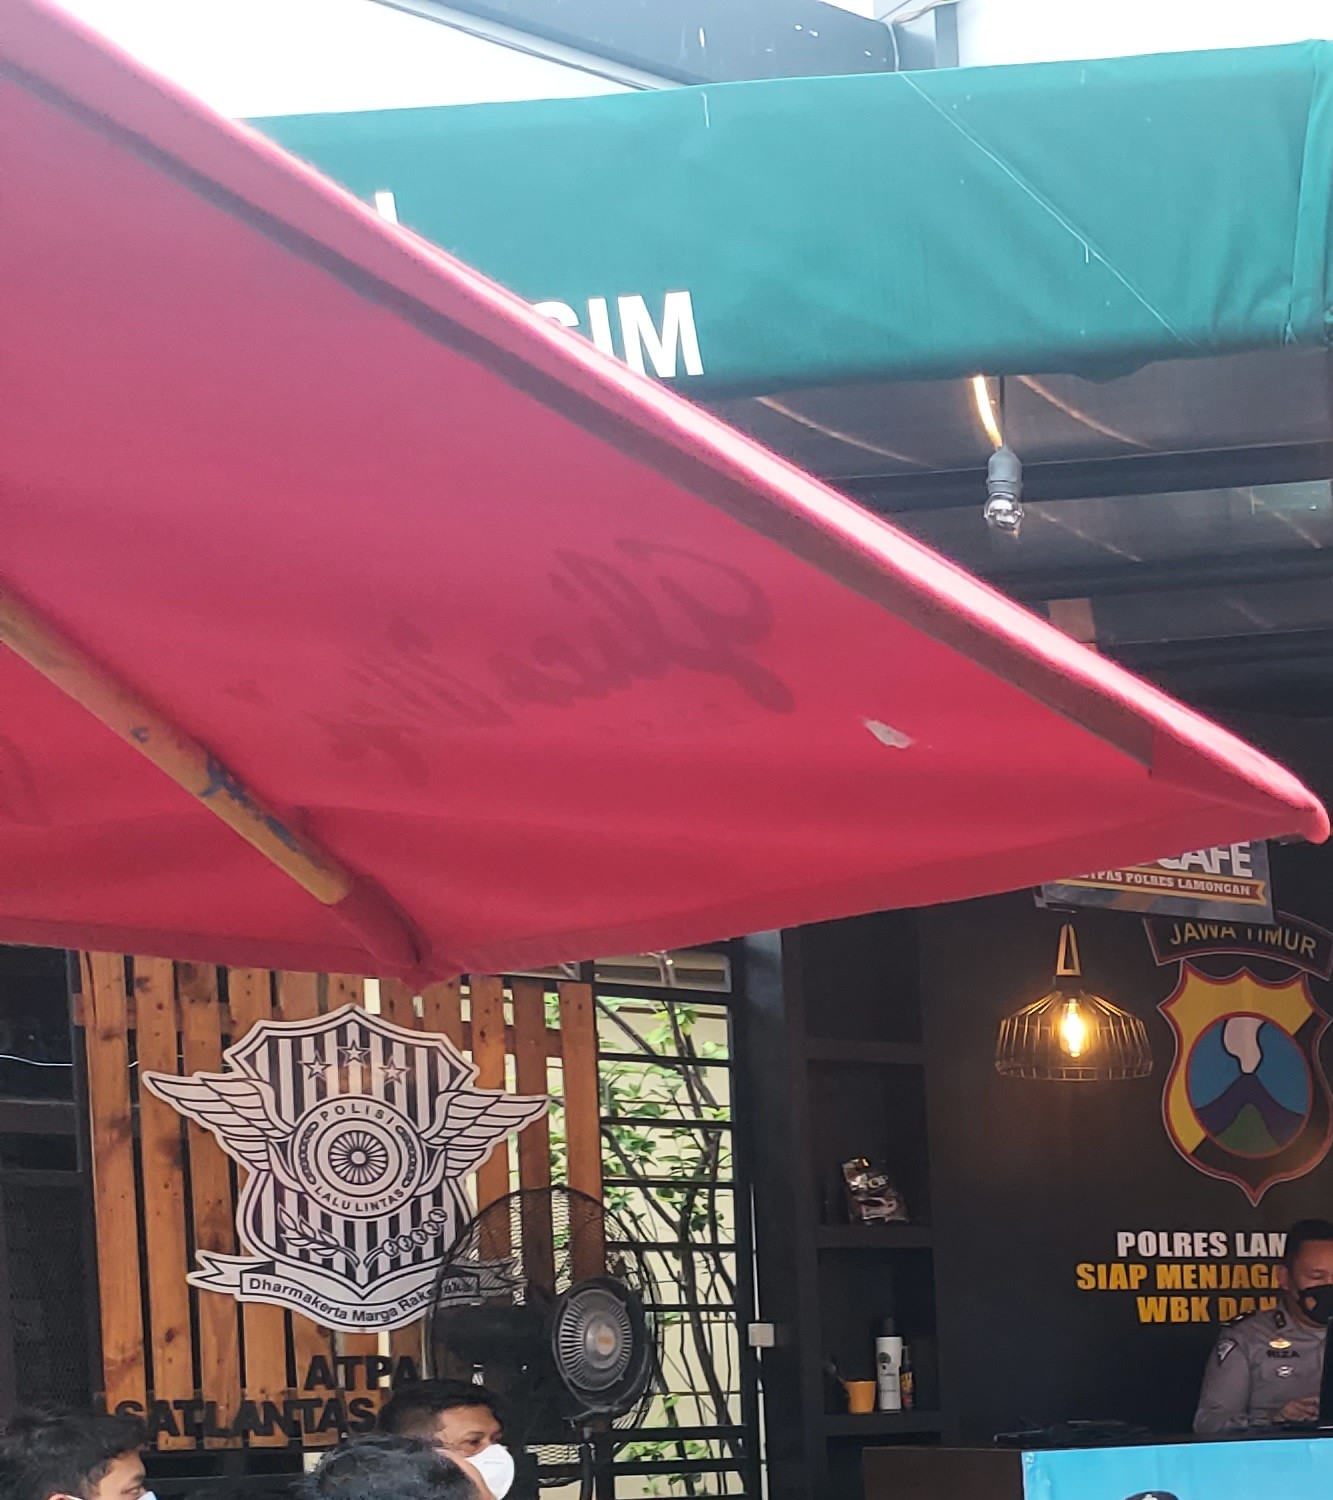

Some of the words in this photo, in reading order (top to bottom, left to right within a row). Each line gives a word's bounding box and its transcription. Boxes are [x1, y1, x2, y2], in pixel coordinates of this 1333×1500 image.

[1126, 872, 1175, 888] POLRES
[1178, 878, 1250, 896] LAMONGAN
[1170, 922, 1237, 946] JAWA
[320, 1103, 395, 1125] POLISI
[314, 1186, 351, 1210] LALU
[355, 1188, 405, 1212] LINTAS
[1117, 1231, 1228, 1258] POLRES
[1076, 1263, 1148, 1291] SIAP
[249, 1277, 348, 1321] Dharmakerta
[352, 1307, 398, 1322] Marga
[1136, 1296, 1210, 1323] WBK
